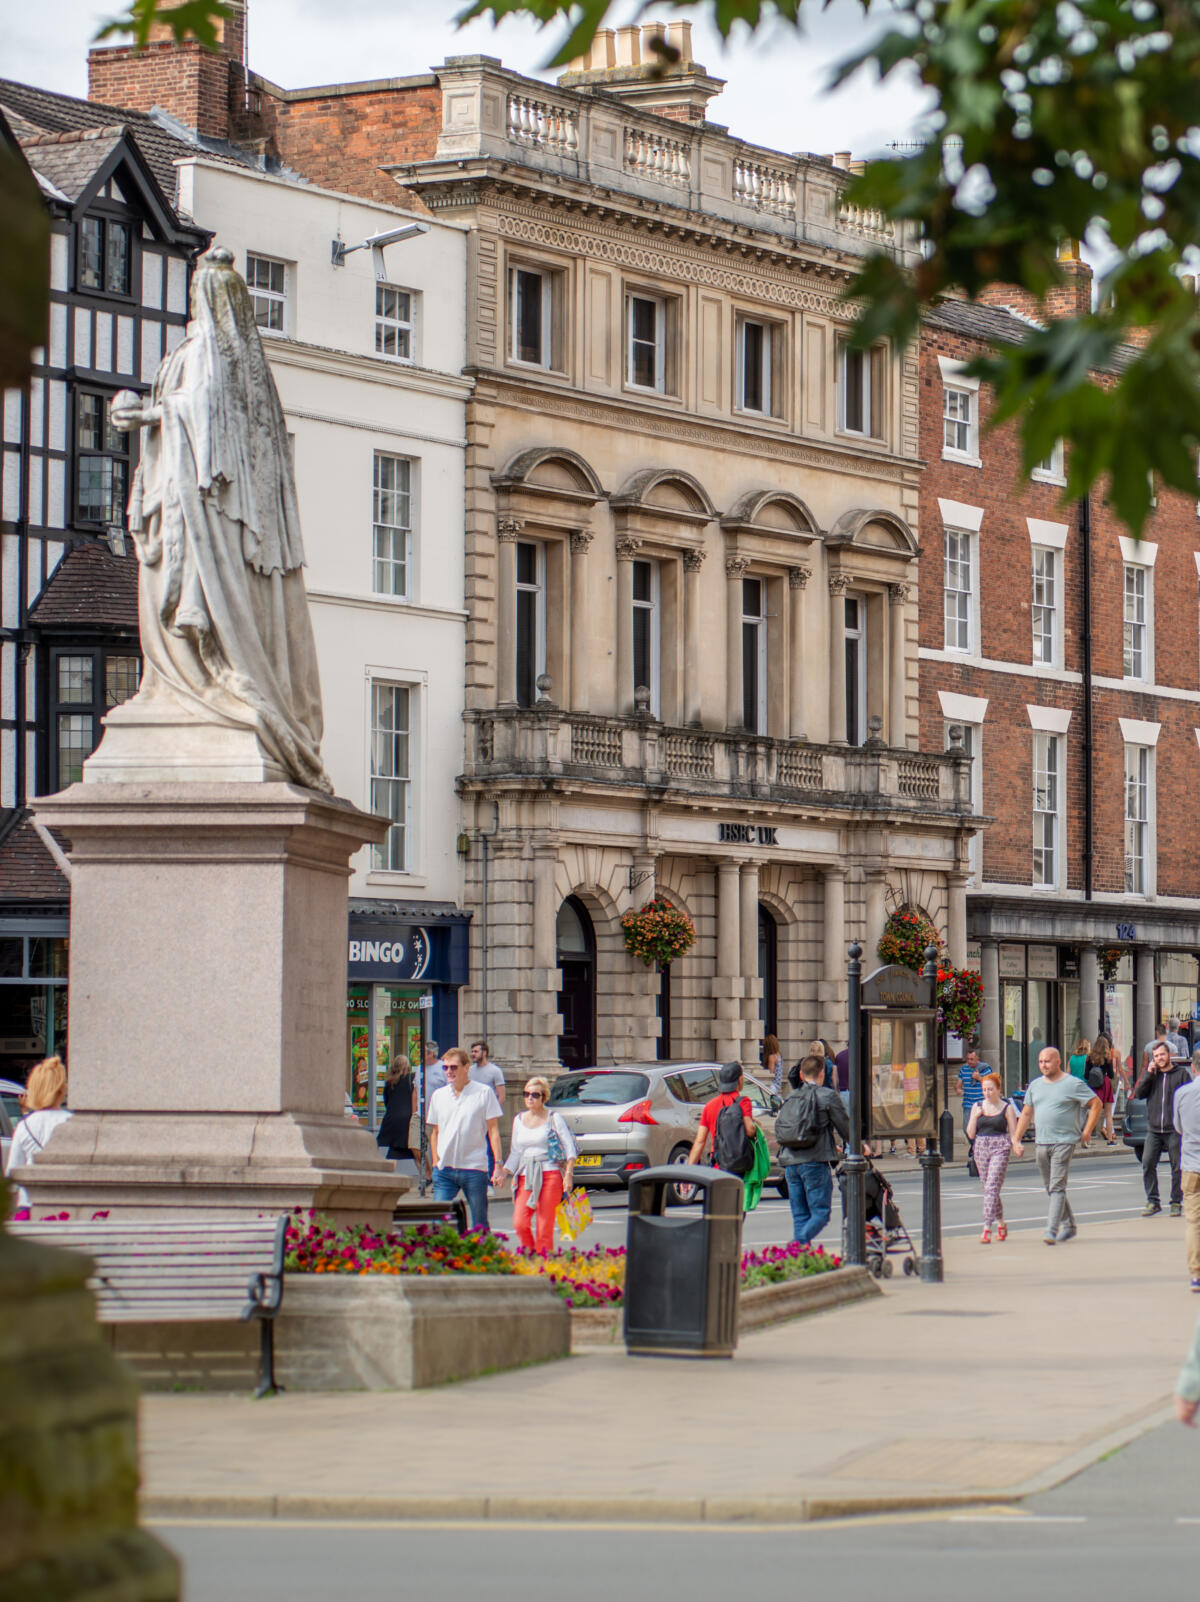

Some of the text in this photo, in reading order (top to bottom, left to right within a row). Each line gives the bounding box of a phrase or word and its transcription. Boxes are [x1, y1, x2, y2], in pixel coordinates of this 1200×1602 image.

[719, 823, 779, 845] HSBC UK
[1117, 923, 1137, 940] 124
[348, 940, 404, 963] BINGO
